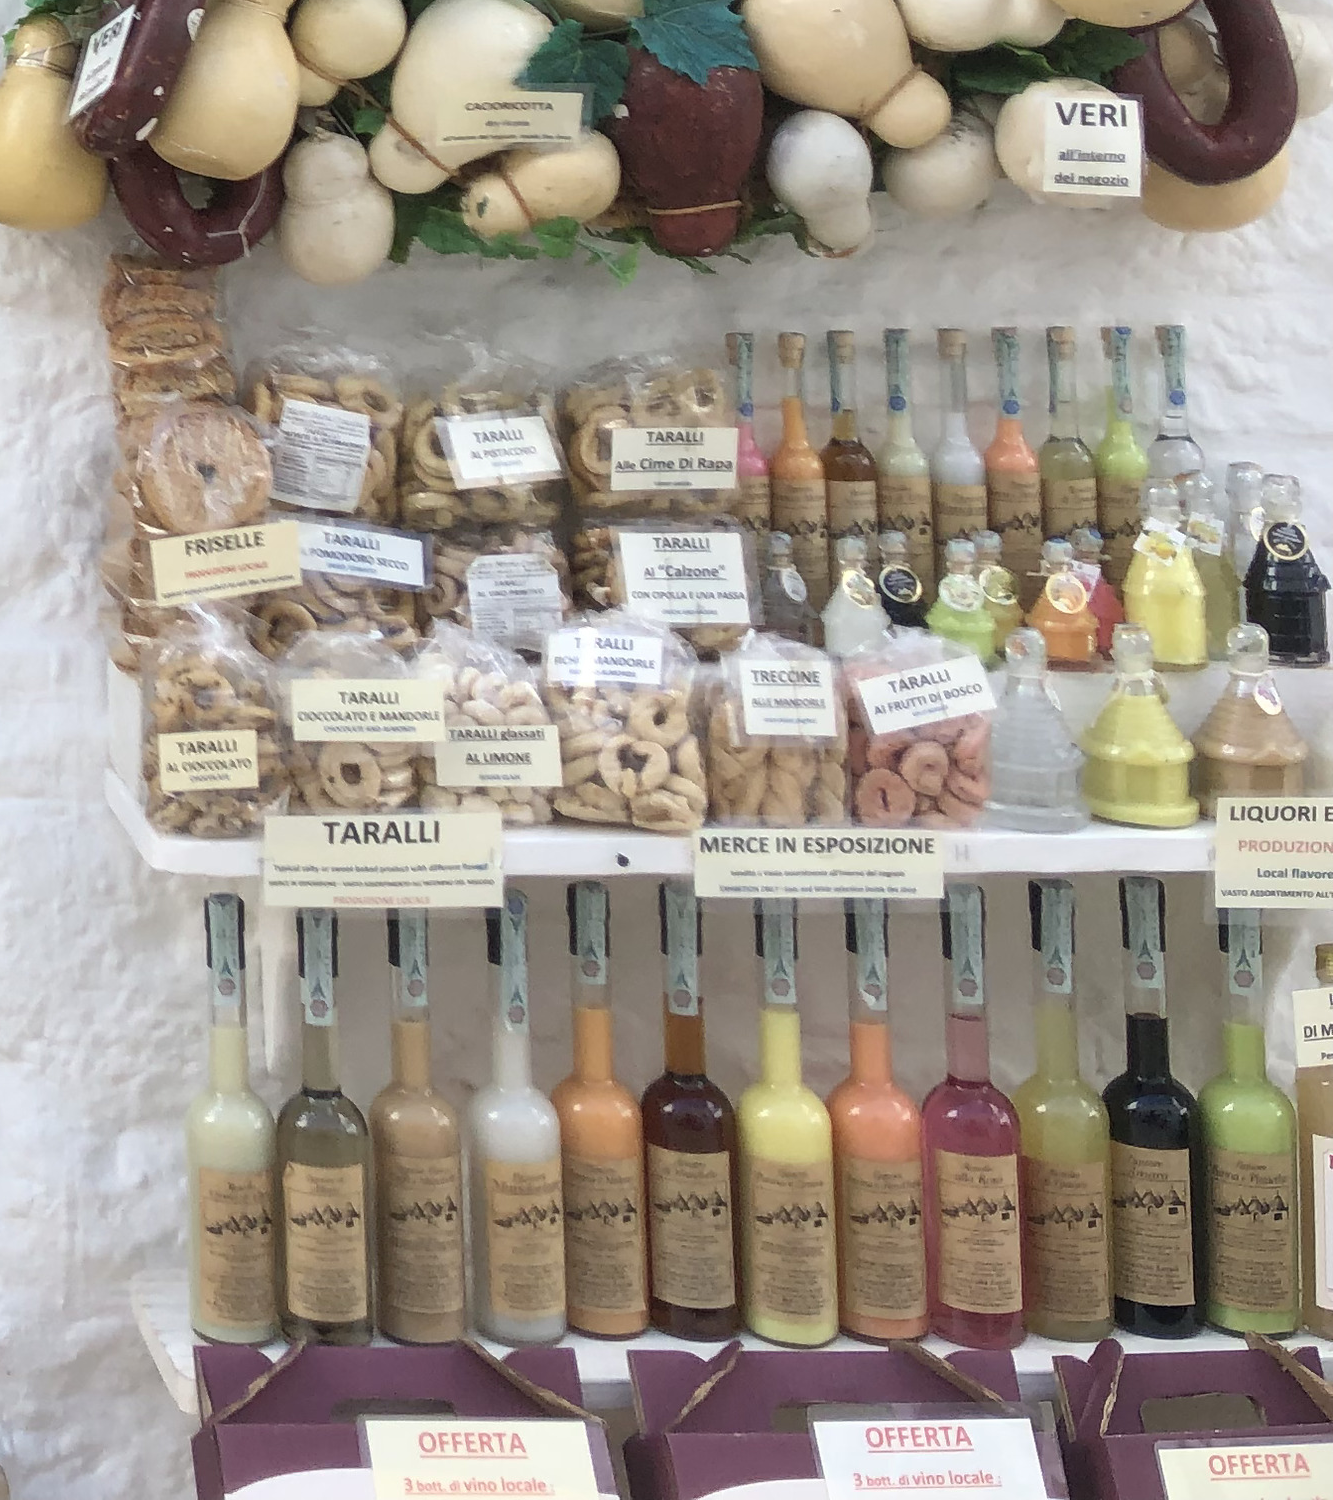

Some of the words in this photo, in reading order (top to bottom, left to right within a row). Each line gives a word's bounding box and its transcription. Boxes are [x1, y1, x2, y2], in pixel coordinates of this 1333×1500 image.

[1056, 102, 1127, 127] VERI
[1058, 149, 1125, 162] all'interno
[1054, 173, 1074, 184] del
[1078, 174, 1128, 187] negozio
[473, 429, 524, 443] TARALLI
[646, 431, 704, 443] TARALLI
[616, 461, 636, 470] Alle
[639, 458, 675, 470] Cime
[679, 457, 693, 469] Di
[697, 458, 733, 472] Rapa
[185, 532, 264, 556] FRISELLE
[323, 532, 381, 551] TARALLI
[653, 537, 711, 550] TARALLI
[632, 591, 650, 600] CON
[716, 591, 745, 600] PASSA
[574, 638, 634, 651] TRALLI
[751, 669, 821, 684] TRECCINE
[887, 669, 952, 694] TARALLI
[338, 691, 400, 705] TARALLI
[887, 696, 925, 713] FRUTTI
[926, 693, 941, 705] DI
[945, 682, 983, 701] BOSCO
[297, 710, 366, 722] CIOCCOLATO
[379, 710, 440, 722] MANDORLE
[449, 729, 497, 740] TARALLI
[500, 727, 545, 741] glassati
[176, 739, 238, 754] TARALLI
[466, 752, 480, 764] AL
[483, 751, 532, 764] LIMONE
[1230, 806, 1317, 823] LIQUORI
[323, 821, 440, 844] TARALLI
[700, 836, 768, 854] MERCE
[776, 836, 796, 853] IN
[803, 836, 935, 854] ESPOSIZIONE
[1257, 868, 1288, 878] Local
[1250, 890, 1313, 898] ASSORTIMENTO
[1304, 1025, 1317, 1038] DI
[418, 1431, 527, 1453] OFFERTA
[865, 1426, 973, 1448] OFFERTA
[1209, 1453, 1310, 1475] OFFERTA
[404, 1478, 413, 1492] 3
[450, 1479, 460, 1491] di
[464, 1477, 497, 1492] vino
[501, 1477, 547, 1493] locale
[853, 1473, 863, 1487] 3
[898, 1474, 909, 1485] di
[913, 1471, 945, 1485] vino
[948, 1470, 993, 1485] locale
